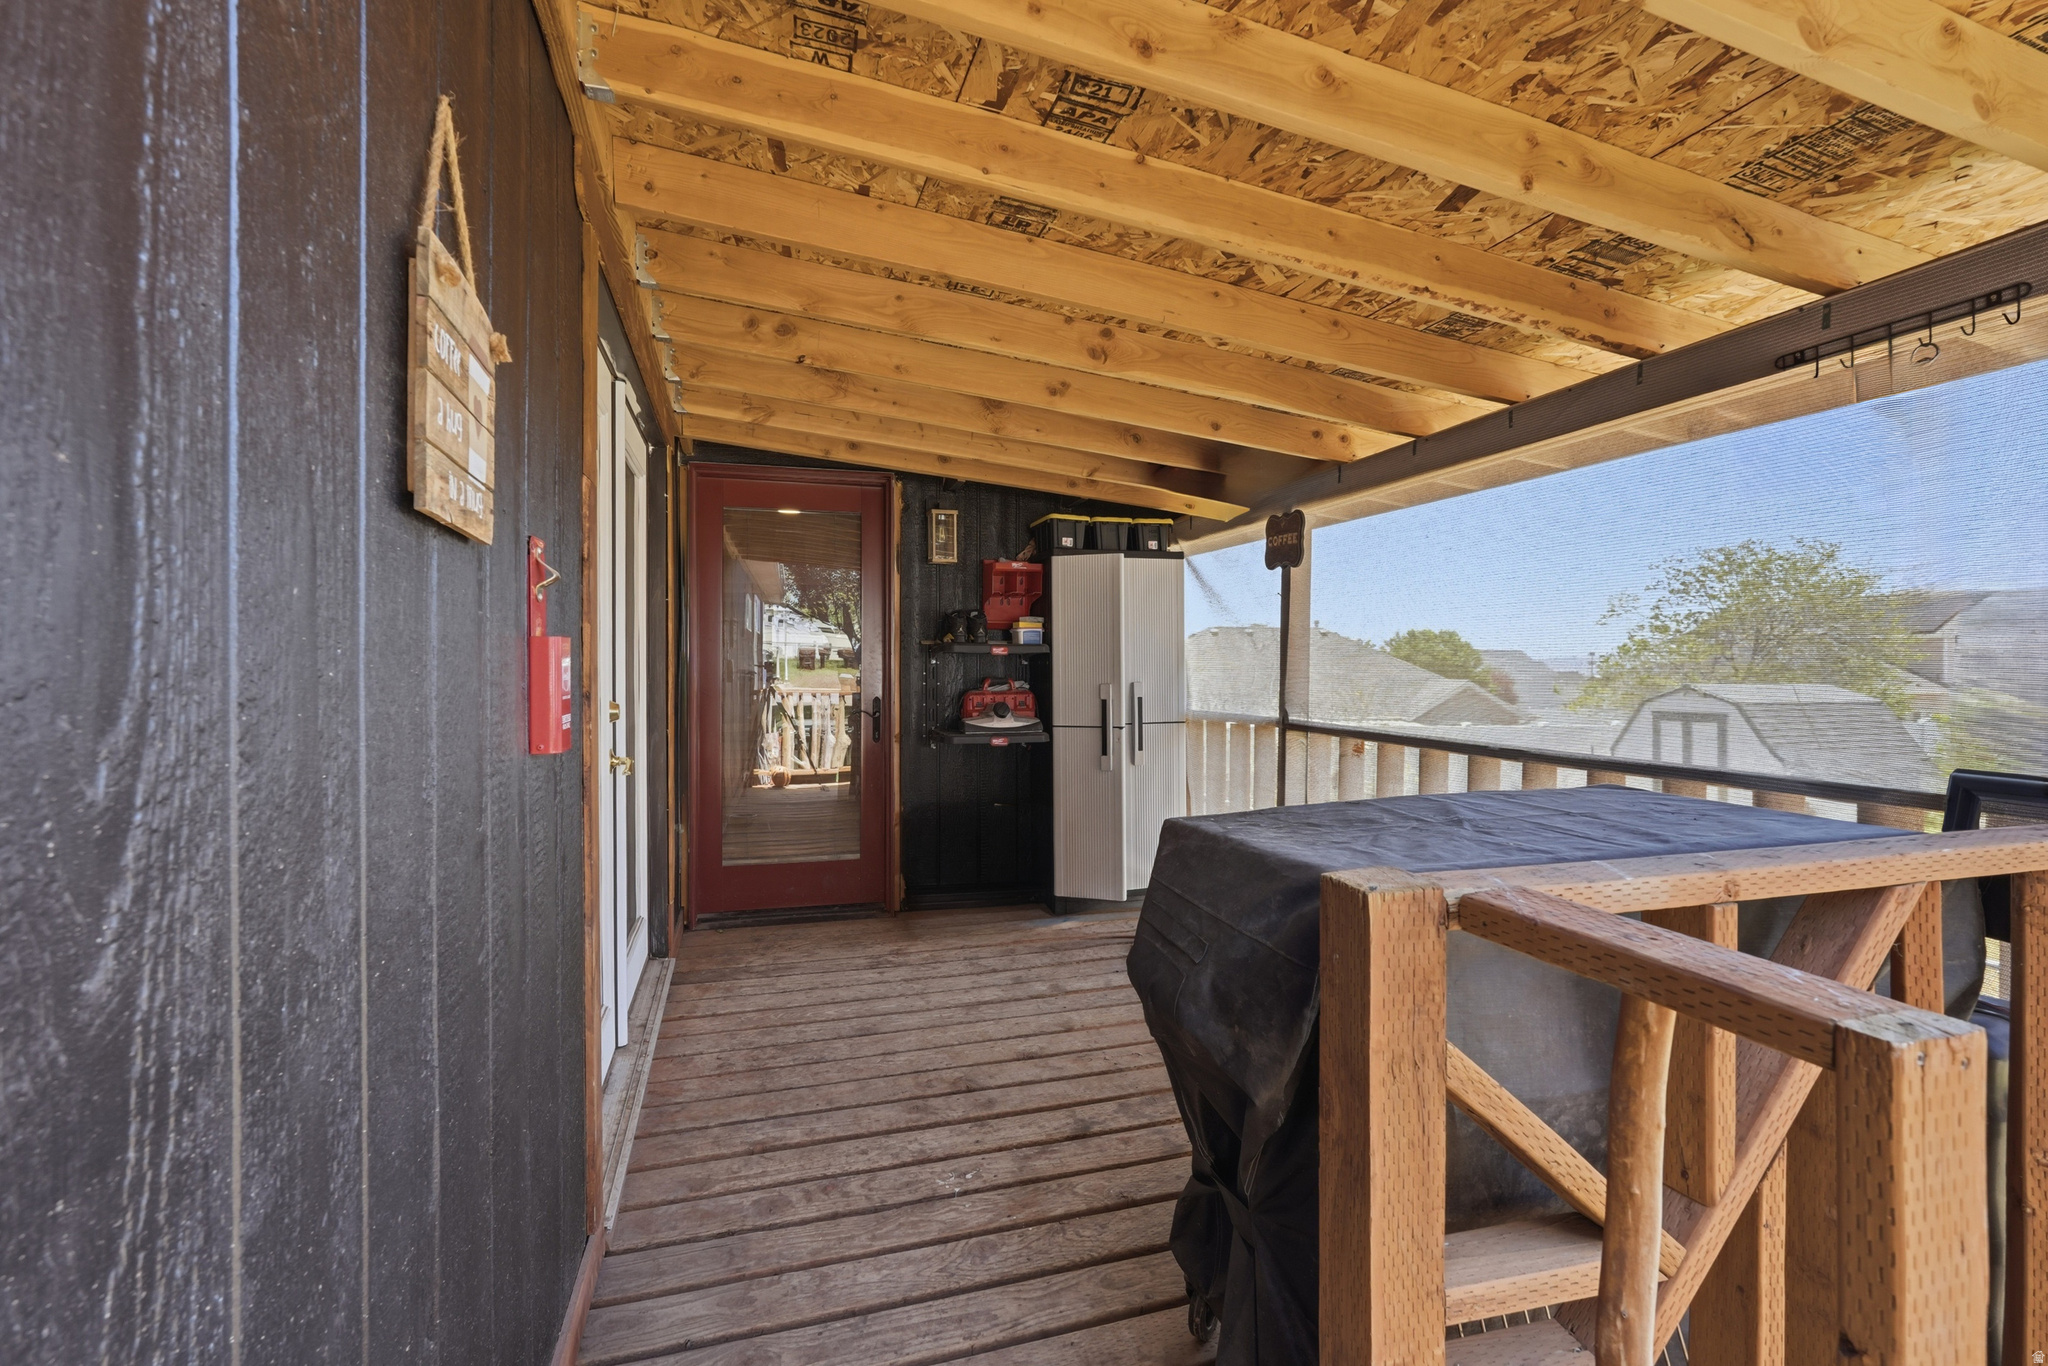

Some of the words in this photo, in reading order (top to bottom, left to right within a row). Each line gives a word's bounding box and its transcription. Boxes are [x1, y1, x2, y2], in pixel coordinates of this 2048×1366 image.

[800, 22, 851, 46] 2023
[1060, 106, 1108, 126] APA
[1267, 532, 1299, 547] COFFEE
